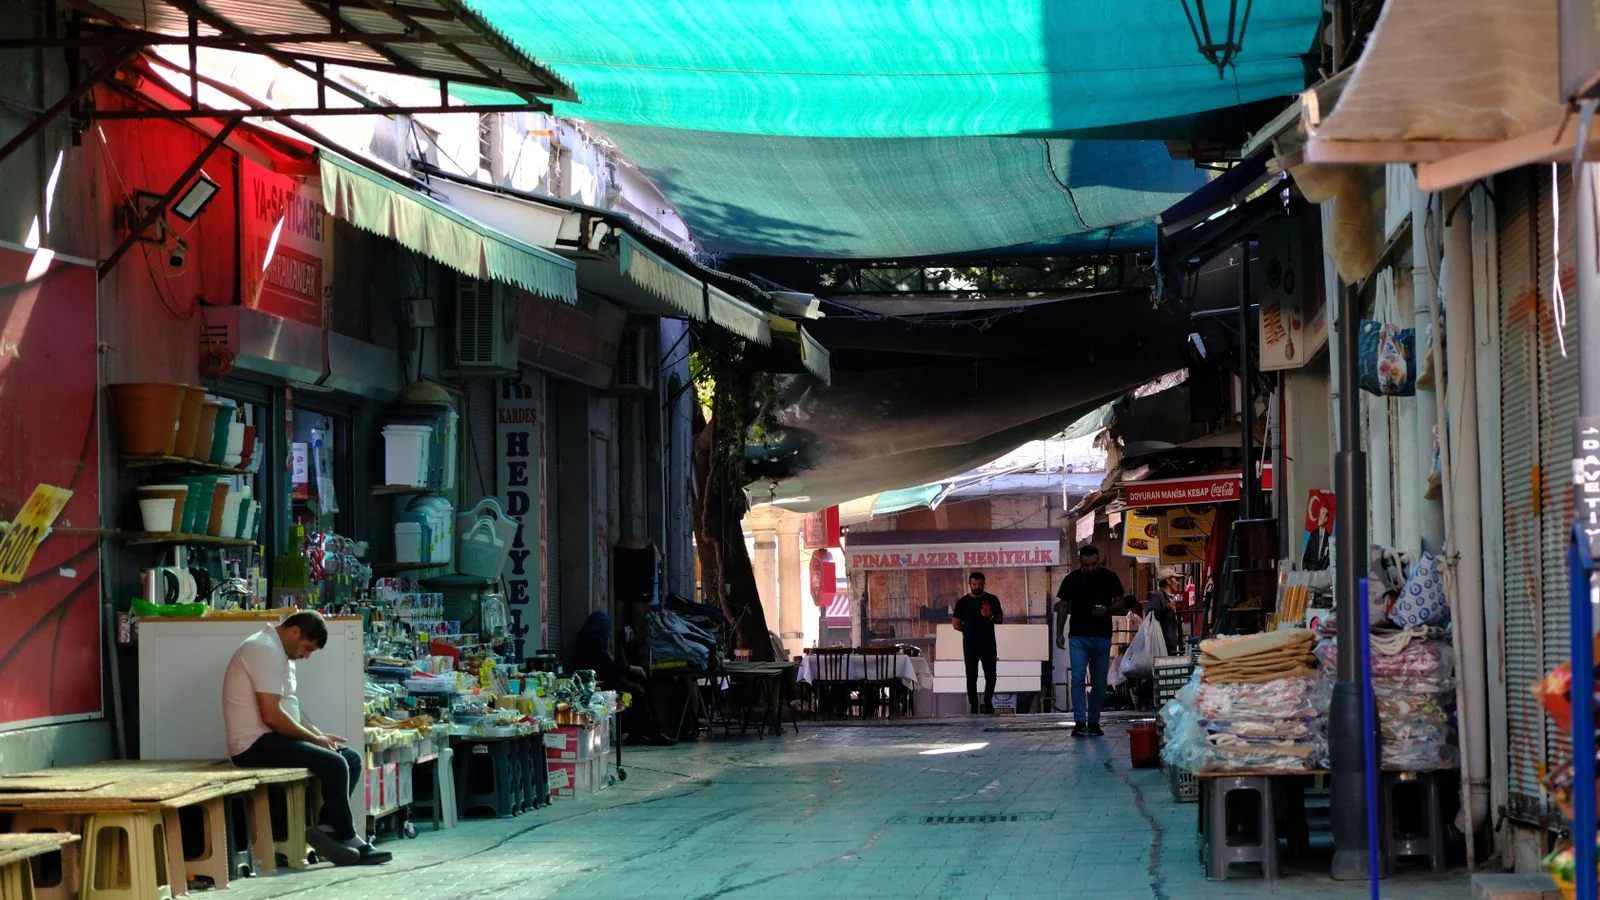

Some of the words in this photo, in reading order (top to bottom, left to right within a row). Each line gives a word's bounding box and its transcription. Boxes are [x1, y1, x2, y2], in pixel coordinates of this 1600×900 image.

[253, 177, 285, 225] YA-SA
[286, 183, 326, 242] TİCARET
[1129, 491, 1161, 501] DOYURAN
[1187, 487, 1210, 498] KEBAP
[852, 553, 902, 568] PINAR
[906, 551, 960, 567] LAZER
[963, 546, 1053, 566] HEDİYELİK
